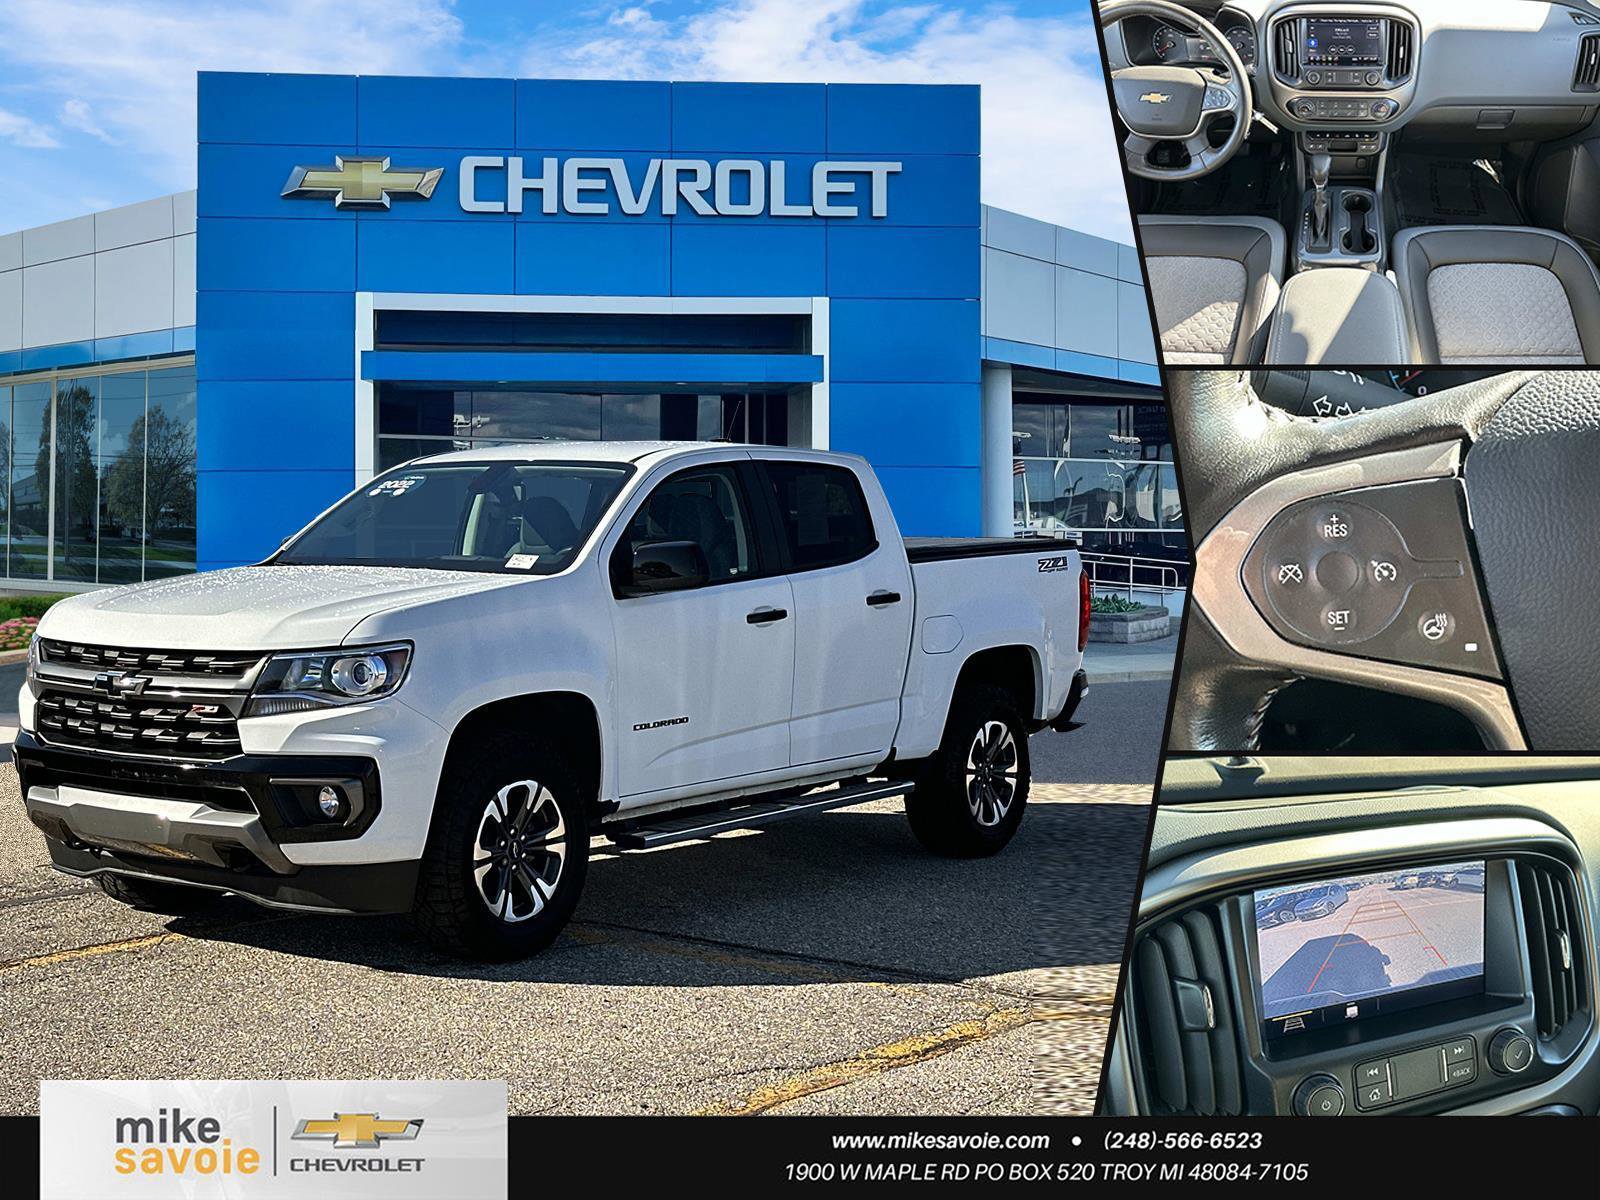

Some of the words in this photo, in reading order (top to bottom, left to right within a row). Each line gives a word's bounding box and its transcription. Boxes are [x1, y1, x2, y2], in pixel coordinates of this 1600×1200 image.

[459, 155, 903, 218] CHEVROLET
[1324, 523, 1348, 538] RES
[1327, 610, 1350, 625] SET
[633, 716, 689, 731] COLORADO
